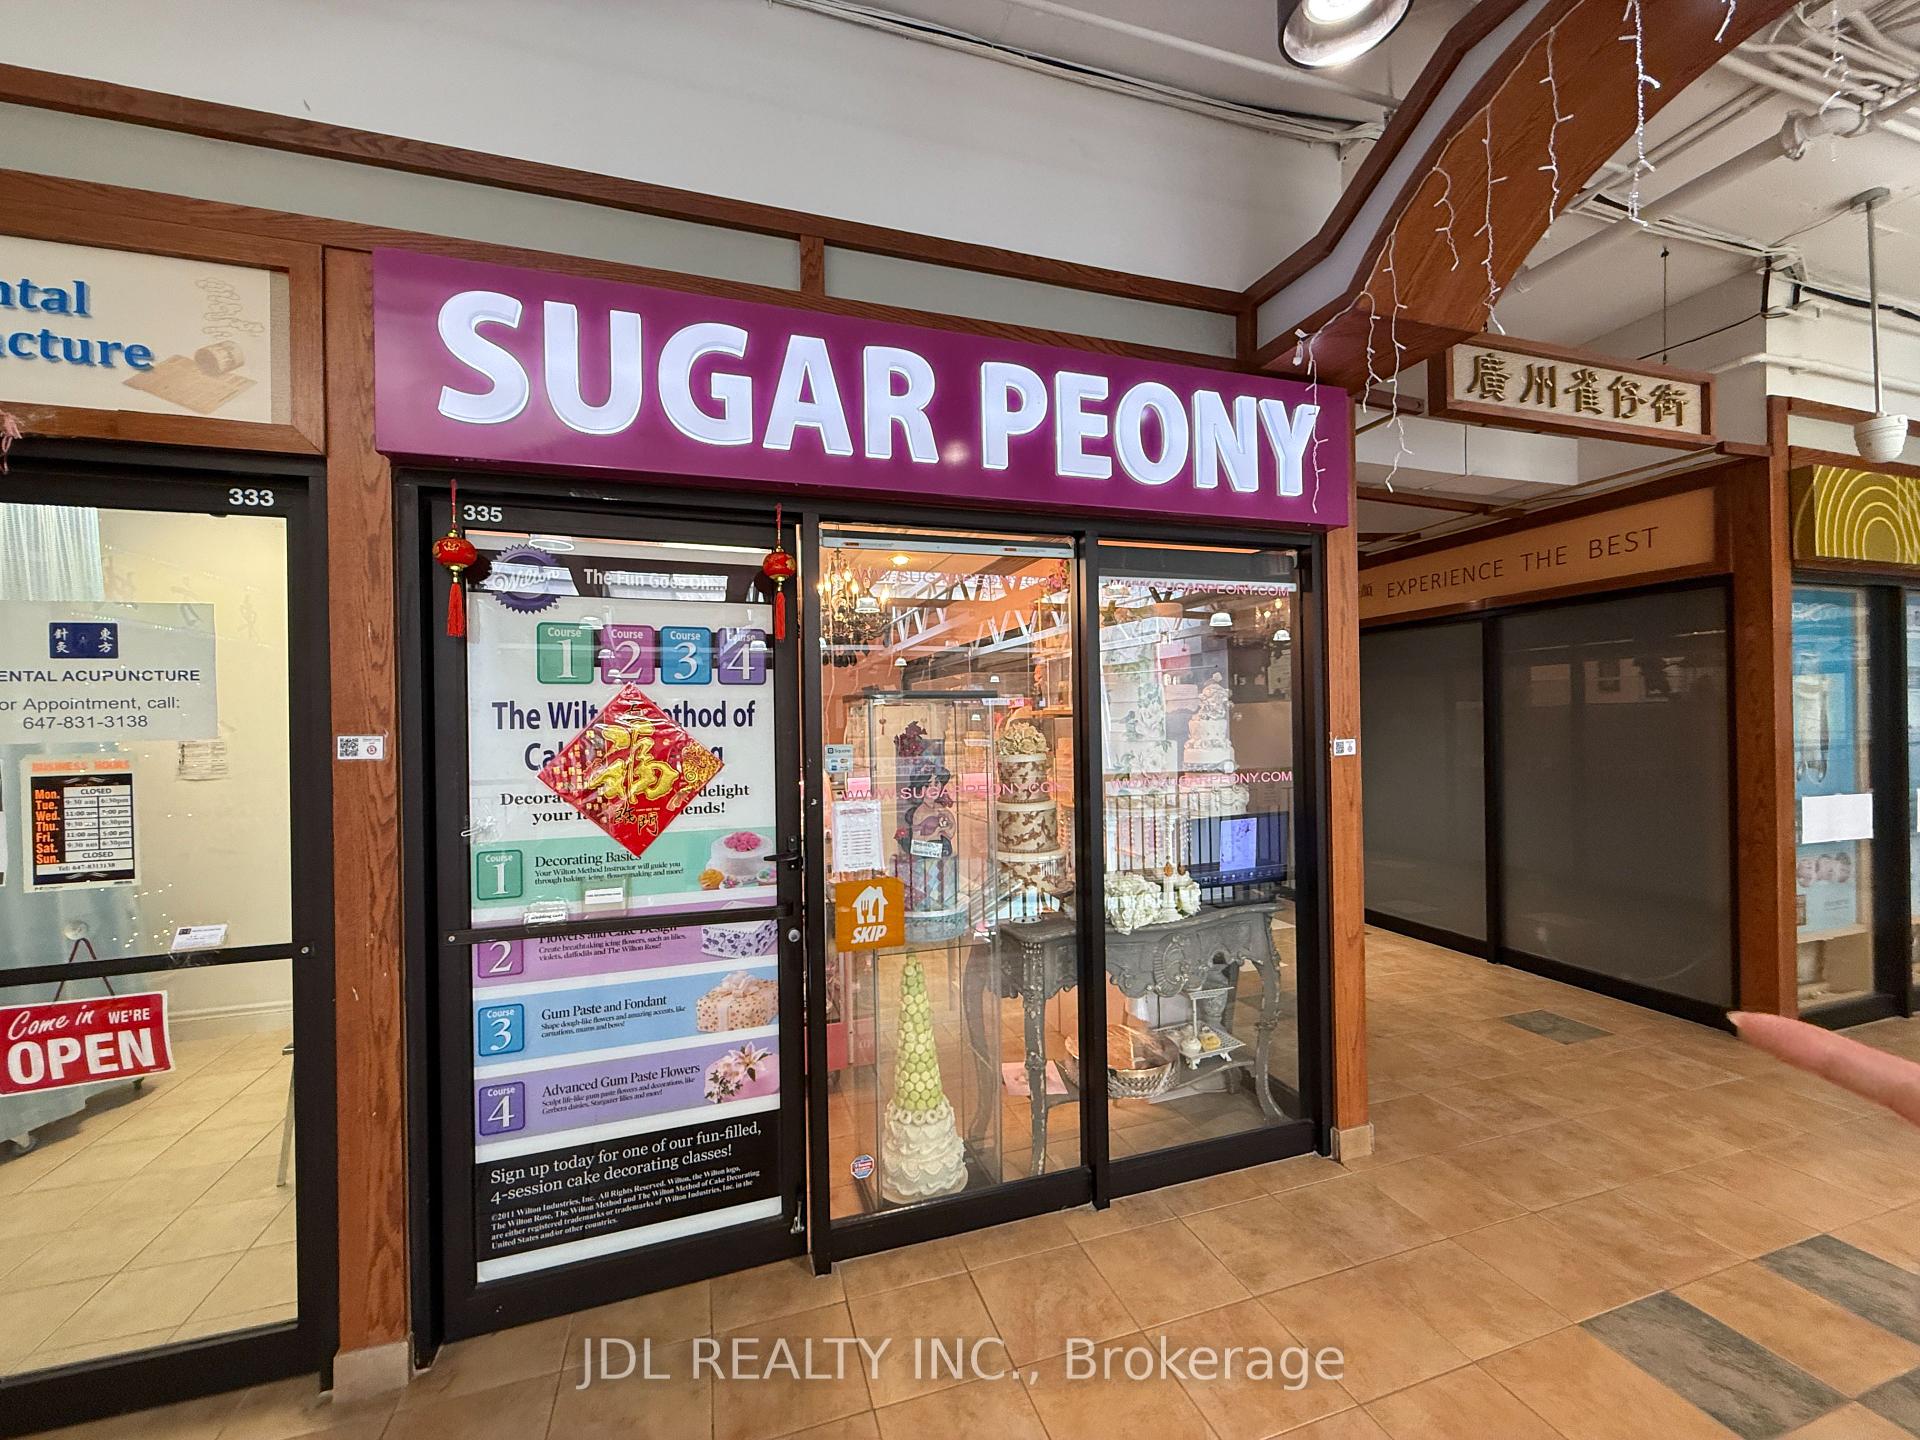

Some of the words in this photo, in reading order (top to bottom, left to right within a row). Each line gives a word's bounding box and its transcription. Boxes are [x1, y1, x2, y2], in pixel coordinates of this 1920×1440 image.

[0, 329, 153, 370] cture
[437, 290, 939, 463] SUGAR
[980, 361, 1320, 496] PEONY
[228, 488, 275, 507] 333
[463, 505, 503, 523] 335
[1387, 559, 1504, 598] EXPERIENCE
[1520, 544, 1567, 573] THE
[1588, 526, 1660, 561] BEST
[583, 568, 612, 587] The
[547, 627, 582, 638] Course
[610, 629, 644, 640] Course
[669, 630, 701, 641] Course
[726, 632, 756, 642] Course
[557, 638, 576, 680] 1
[619, 640, 643, 680] 2
[673, 641, 699, 680] 3
[726, 644, 755, 680] 4
[62, 670, 201, 682] ACUPUNCTURE
[23, 697, 142, 713] Appointment,
[147, 696, 180, 710] call:
[23, 715, 148, 730] 647-831-3138
[491, 700, 541, 730] The
[548, 700, 599, 729] Wilt
[733, 700, 756, 728] of
[35, 789, 60, 800] Mon.
[35, 800, 58, 810] Tue.
[35, 811, 61, 821] Wed.
[532, 810, 574, 825] your
[36, 821, 59, 832] Thu.
[36, 832, 54, 843] Fri.
[36, 843, 58, 853] Sat.
[36, 854, 60, 864] Sun.
[82, 851, 114, 859] CLOSED
[484, 853, 514, 863] Course
[535, 853, 603, 867] Decorating
[493, 863, 509, 895] 1
[577, 866, 603, 874] Method
[604, 865, 636, 873] Instructor
[535, 876, 562, 885] through
[851, 925, 887, 944] SKIP
[538, 944, 561, 954] Create
[562, 941, 604, 951] breathtaking
[563, 949, 593, 958] daffodils
[594, 948, 607, 956] and
[607, 947, 621, 955] The
[621, 944, 644, 952] Wilton
[489, 941, 513, 974] 2
[486, 1007, 515, 1018] Course
[541, 1008, 570, 1020] Gum
[573, 1004, 602, 1016] Paste
[604, 1000, 622, 1012] and
[624, 995, 667, 1009] Fondant
[7, 1010, 70, 1041] Come
[75, 1005, 95, 1026] in
[108, 1007, 151, 1024] WE'RE
[540, 1022, 559, 1031] Shape
[560, 1018, 593, 1027] dough-like
[593, 1015, 615, 1023] flowers
[628, 1010, 652, 1019] amazing
[490, 1019, 510, 1051] 3
[7, 1027, 156, 1085] OPEN
[542, 1078, 599, 1098] Advanced
[600, 1075, 628, 1088] Gum
[630, 1070, 658, 1084] Paste
[660, 1064, 701, 1079] Flowers
[487, 1086, 516, 1097] Course
[542, 1098, 562, 1107] Sculpt
[585, 1093, 600, 1101] gum
[600, 1090, 616, 1099] paste
[616, 1086, 638, 1095] flowers
[487, 1098, 515, 1129] 4
[542, 1106, 567, 1115] Gerbera
[490, 1168, 526, 1185] Sign
[529, 1164, 550, 1178] up
[554, 1154, 595, 1172] today
[598, 1147, 620, 1164] for
[622, 1145, 649, 1159] one
[651, 1138, 667, 1153] of
[669, 1136, 694, 1150] our
[696, 1121, 762, 1146] fun-filled,
[490, 1179, 563, 1205] 4-session
[566, 1171, 600, 1188] cake
[603, 1157, 679, 1182] decorating
[682, 1143, 732, 1165] classes!
[491, 1223, 506, 1231] The
[507, 1217, 533, 1227] Wilton
[570, 1204, 594, 1214] Wilton
[595, 1198, 622, 1209] Method
[623, 1196, 636, 1204] and
[638, 1192, 651, 1200] The
[652, 1188, 674, 1197] Wilton
[675, 1181, 701, 1192] Method
[709, 1176, 725, 1186] Cake
[726, 1170, 760, 1181] Decorating
[516, 1206, 541, 1216] Wilton
[582, 1195, 596, 1203] Inc.
[599, 1191, 610, 1200] All
[611, 1186, 633, 1198] Rights
[634, 1180, 666, 1192] Reserved.
[703, 1168, 726, 1177] Wilton
[491, 1232, 503, 1240] are
[504, 1229, 526, 1237] either
[527, 1220, 562, 1233] registered
[564, 1212, 605, 1224] trademarks
[614, 1201, 654, 1215] trademarks
[664, 1193, 687, 1203] Wilton
[743, 1179, 753, 1187] the
[491, 1238, 516, 1250] United
[517, 1234, 539, 1245] States
[564, 1225, 583, 1234] other
[584, 1217, 618, 1229] countries.
